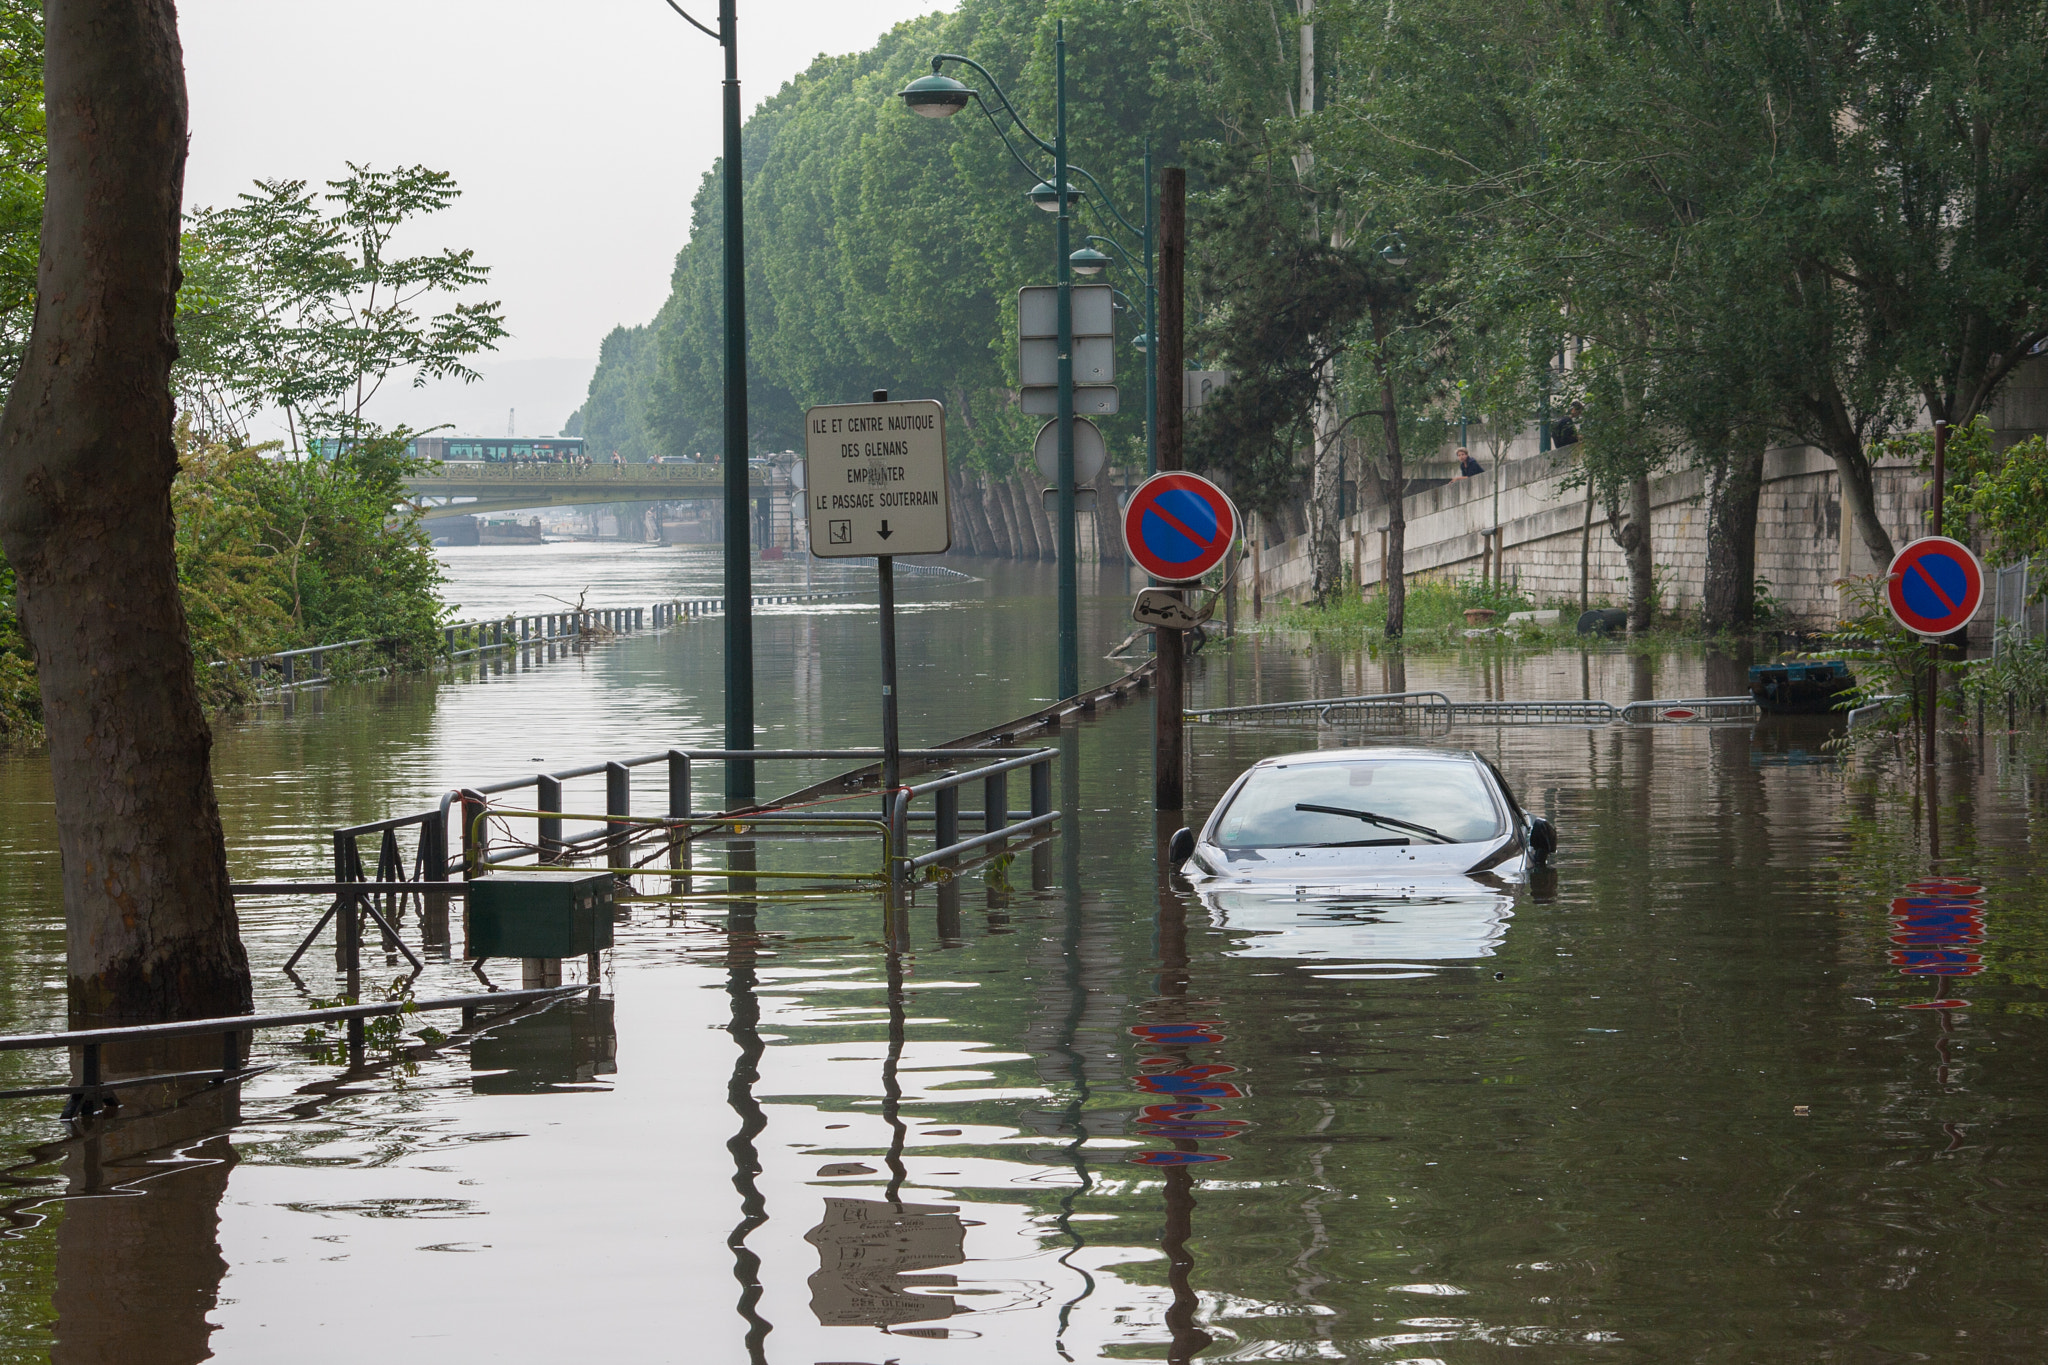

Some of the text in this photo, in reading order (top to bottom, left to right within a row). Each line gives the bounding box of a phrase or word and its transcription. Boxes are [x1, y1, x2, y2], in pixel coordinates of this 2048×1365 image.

[813, 415, 934, 433] ILE ET CENTRE NAUTIQUE
[842, 441, 908, 457] DES GLENANS
[816, 491, 938, 510] LE PASSAGE SOUTERRAIN
